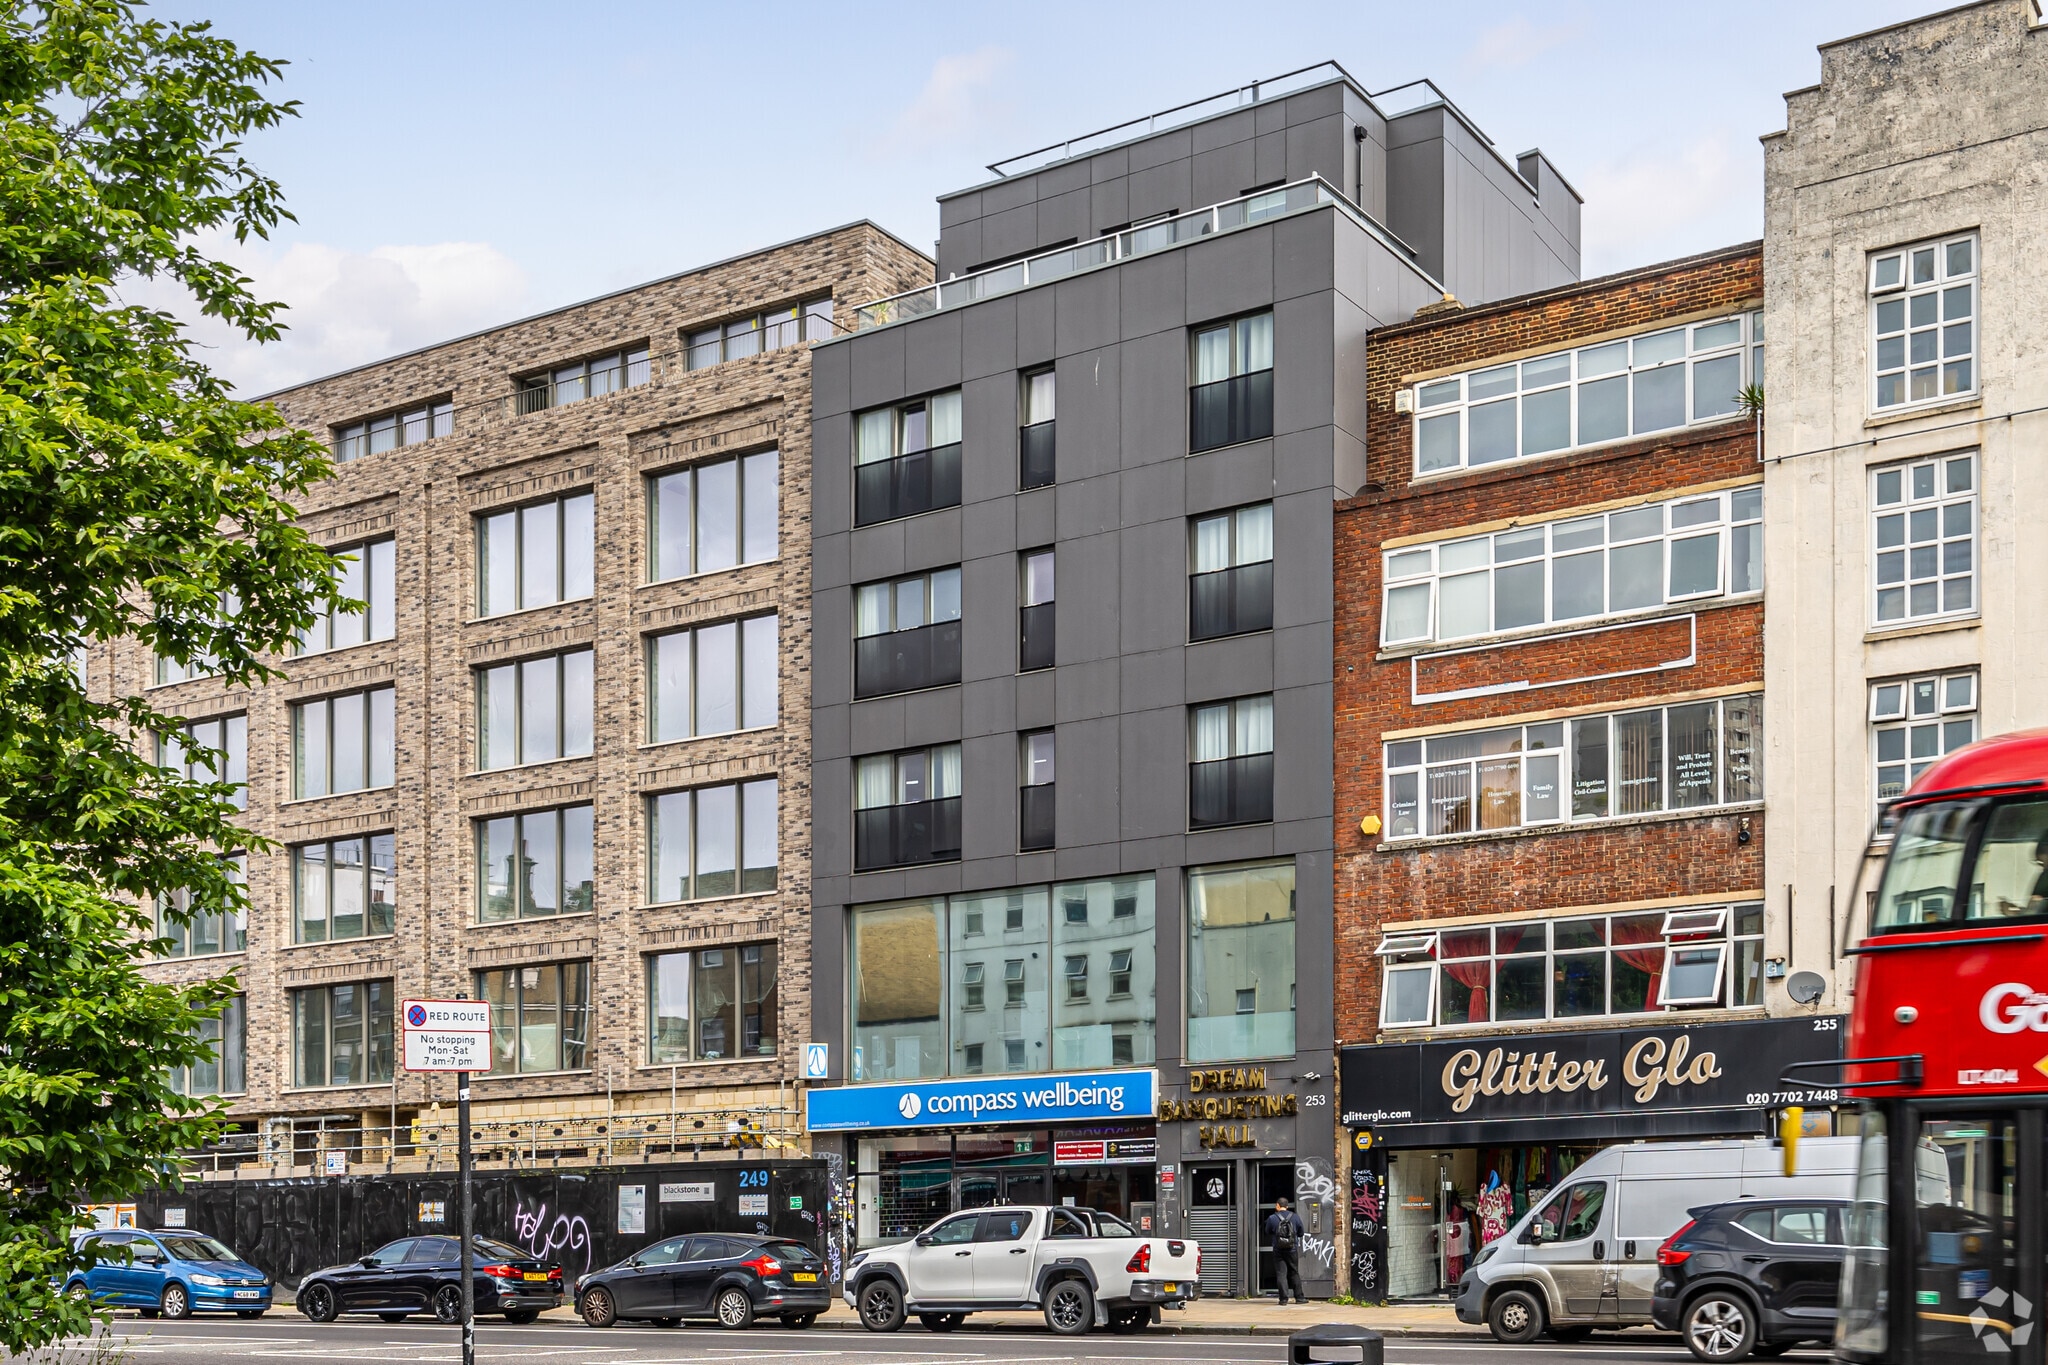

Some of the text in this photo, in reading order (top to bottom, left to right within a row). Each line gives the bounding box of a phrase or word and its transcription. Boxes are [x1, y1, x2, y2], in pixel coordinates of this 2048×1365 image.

[1694, 752, 1710, 760] Trust
[1689, 761, 1712, 769] Probate
[1533, 784, 1553, 792] Family
[1576, 779, 1605, 788] Litigation
[1687, 778, 1711, 787] Appeals
[1392, 801, 1416, 809] Criminal
[1432, 795, 1467, 805] Employment
[430, 1012, 486, 1022] RED ROUTE
[1813, 1019, 1837, 1031] 255
[420, 1035, 475, 1046] No stopping
[458, 1058, 473, 1067] pm
[1441, 1034, 1722, 1113] Glitter Glo
[1190, 1067, 1267, 1093] DREAM
[927, 1080, 1124, 1118] compass wellbeing
[1305, 1095, 1326, 1107] 253
[1746, 1089, 1838, 1104] 020 7702 7448
[1159, 1093, 1299, 1122] BANQUETING
[1342, 1109, 1411, 1124] glitterglo.com
[1199, 1124, 1257, 1149] HALL
[739, 1171, 768, 1188] 249
[663, 1186, 700, 1194] blackstone
